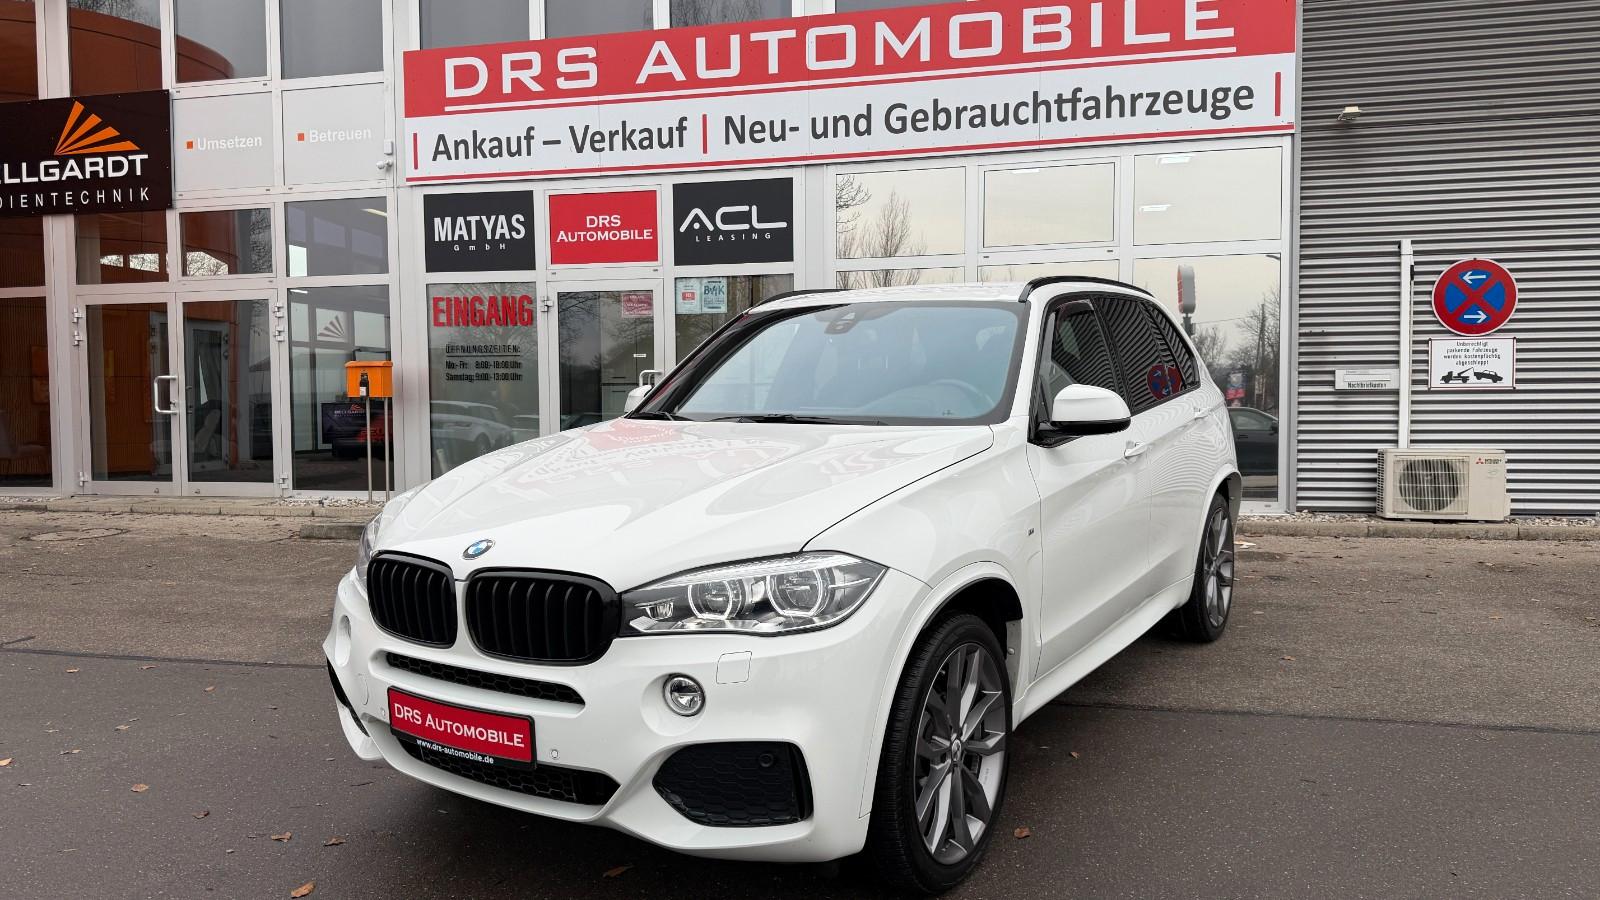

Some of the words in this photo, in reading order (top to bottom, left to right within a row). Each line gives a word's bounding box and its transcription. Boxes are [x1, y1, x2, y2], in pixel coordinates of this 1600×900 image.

[444, 46, 599, 98] DRS
[635, 0, 1235, 84] AUTOMOBILE
[309, 127, 372, 143] Betreuen
[432, 126, 535, 161] Ankauf
[568, 116, 688, 154] Verkauf
[724, 114, 800, 145] Neu-
[810, 103, 873, 140] und
[883, 85, 1255, 135] Gebrauchtfahrzeuge
[197, 135, 263, 151] Umsetzen
[0, 153, 149, 184] LLGARDT
[0, 187, 150, 209] IENTECHNIK
[433, 213, 526, 242] MATYAS
[585, 214, 622, 228] DRS
[679, 204, 788, 233] ACL
[556, 228, 653, 243] AUTOMOBILE
[695, 232, 772, 243] LEASING
[432, 294, 534, 327] EINGANG
[394, 703, 422, 726] DRS
[425, 713, 525, 748] AUTOMOBILE
[416, 739, 495, 765] www.drs-automobile.de
